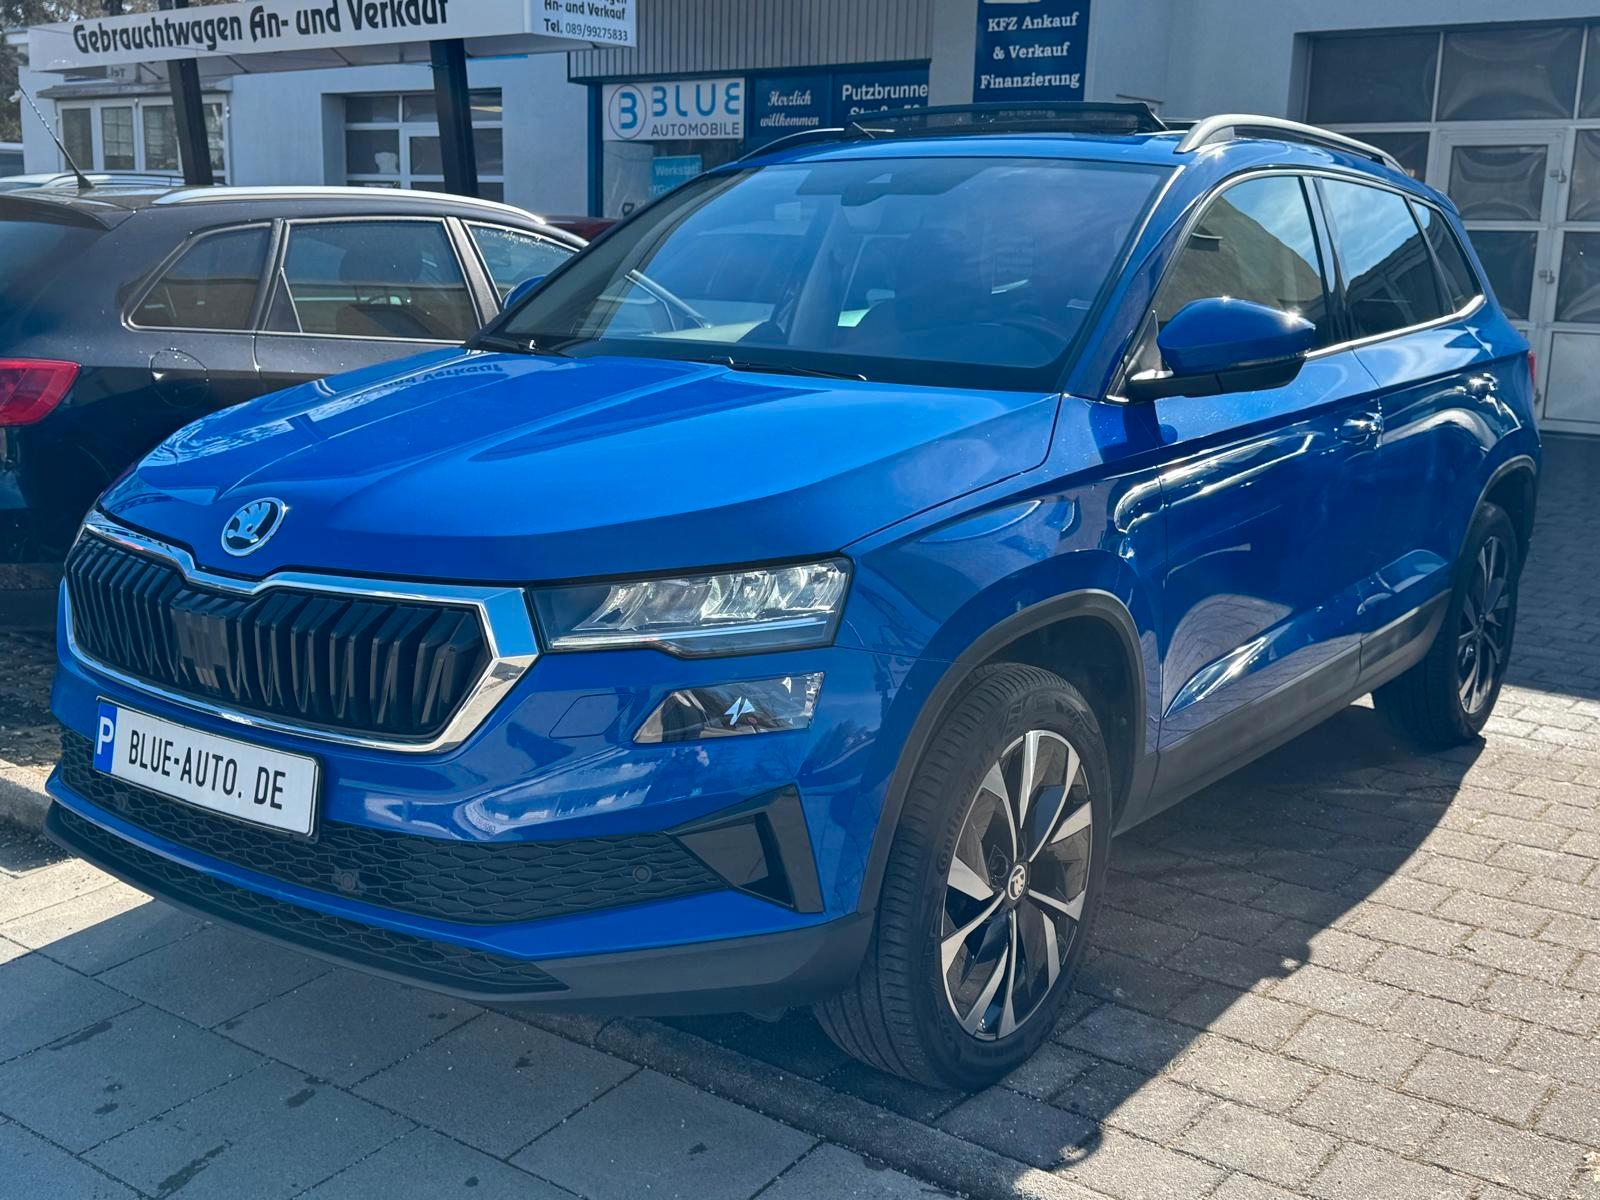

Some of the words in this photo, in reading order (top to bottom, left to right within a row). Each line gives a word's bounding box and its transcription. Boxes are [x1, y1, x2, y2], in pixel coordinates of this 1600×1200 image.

[565, 2, 585, 15] und
[588, 3, 626, 20] Verkauf
[73, 15, 243, 54] Gebrauchtwagen
[250, 5, 289, 43] An-
[296, 0, 341, 35] und
[347, 0, 449, 30] Verkauf
[544, 18, 563, 34] Tel.
[565, 22, 628, 41] 089/99275833
[987, 16, 1018, 32] KFZ
[1022, 12, 1079, 29] Ankauf
[993, 47, 1005, 60] &
[1009, 42, 1070, 58] Verkauf
[980, 72, 1080, 89] Finanzierung
[652, 82, 741, 117] BLUE
[768, 90, 811, 107] Herzlich
[760, 112, 819, 127] willkommen
[651, 122, 740, 137] AUTOMOBILE
[96, 716, 114, 755] P
[254, 766, 286, 810] DE
